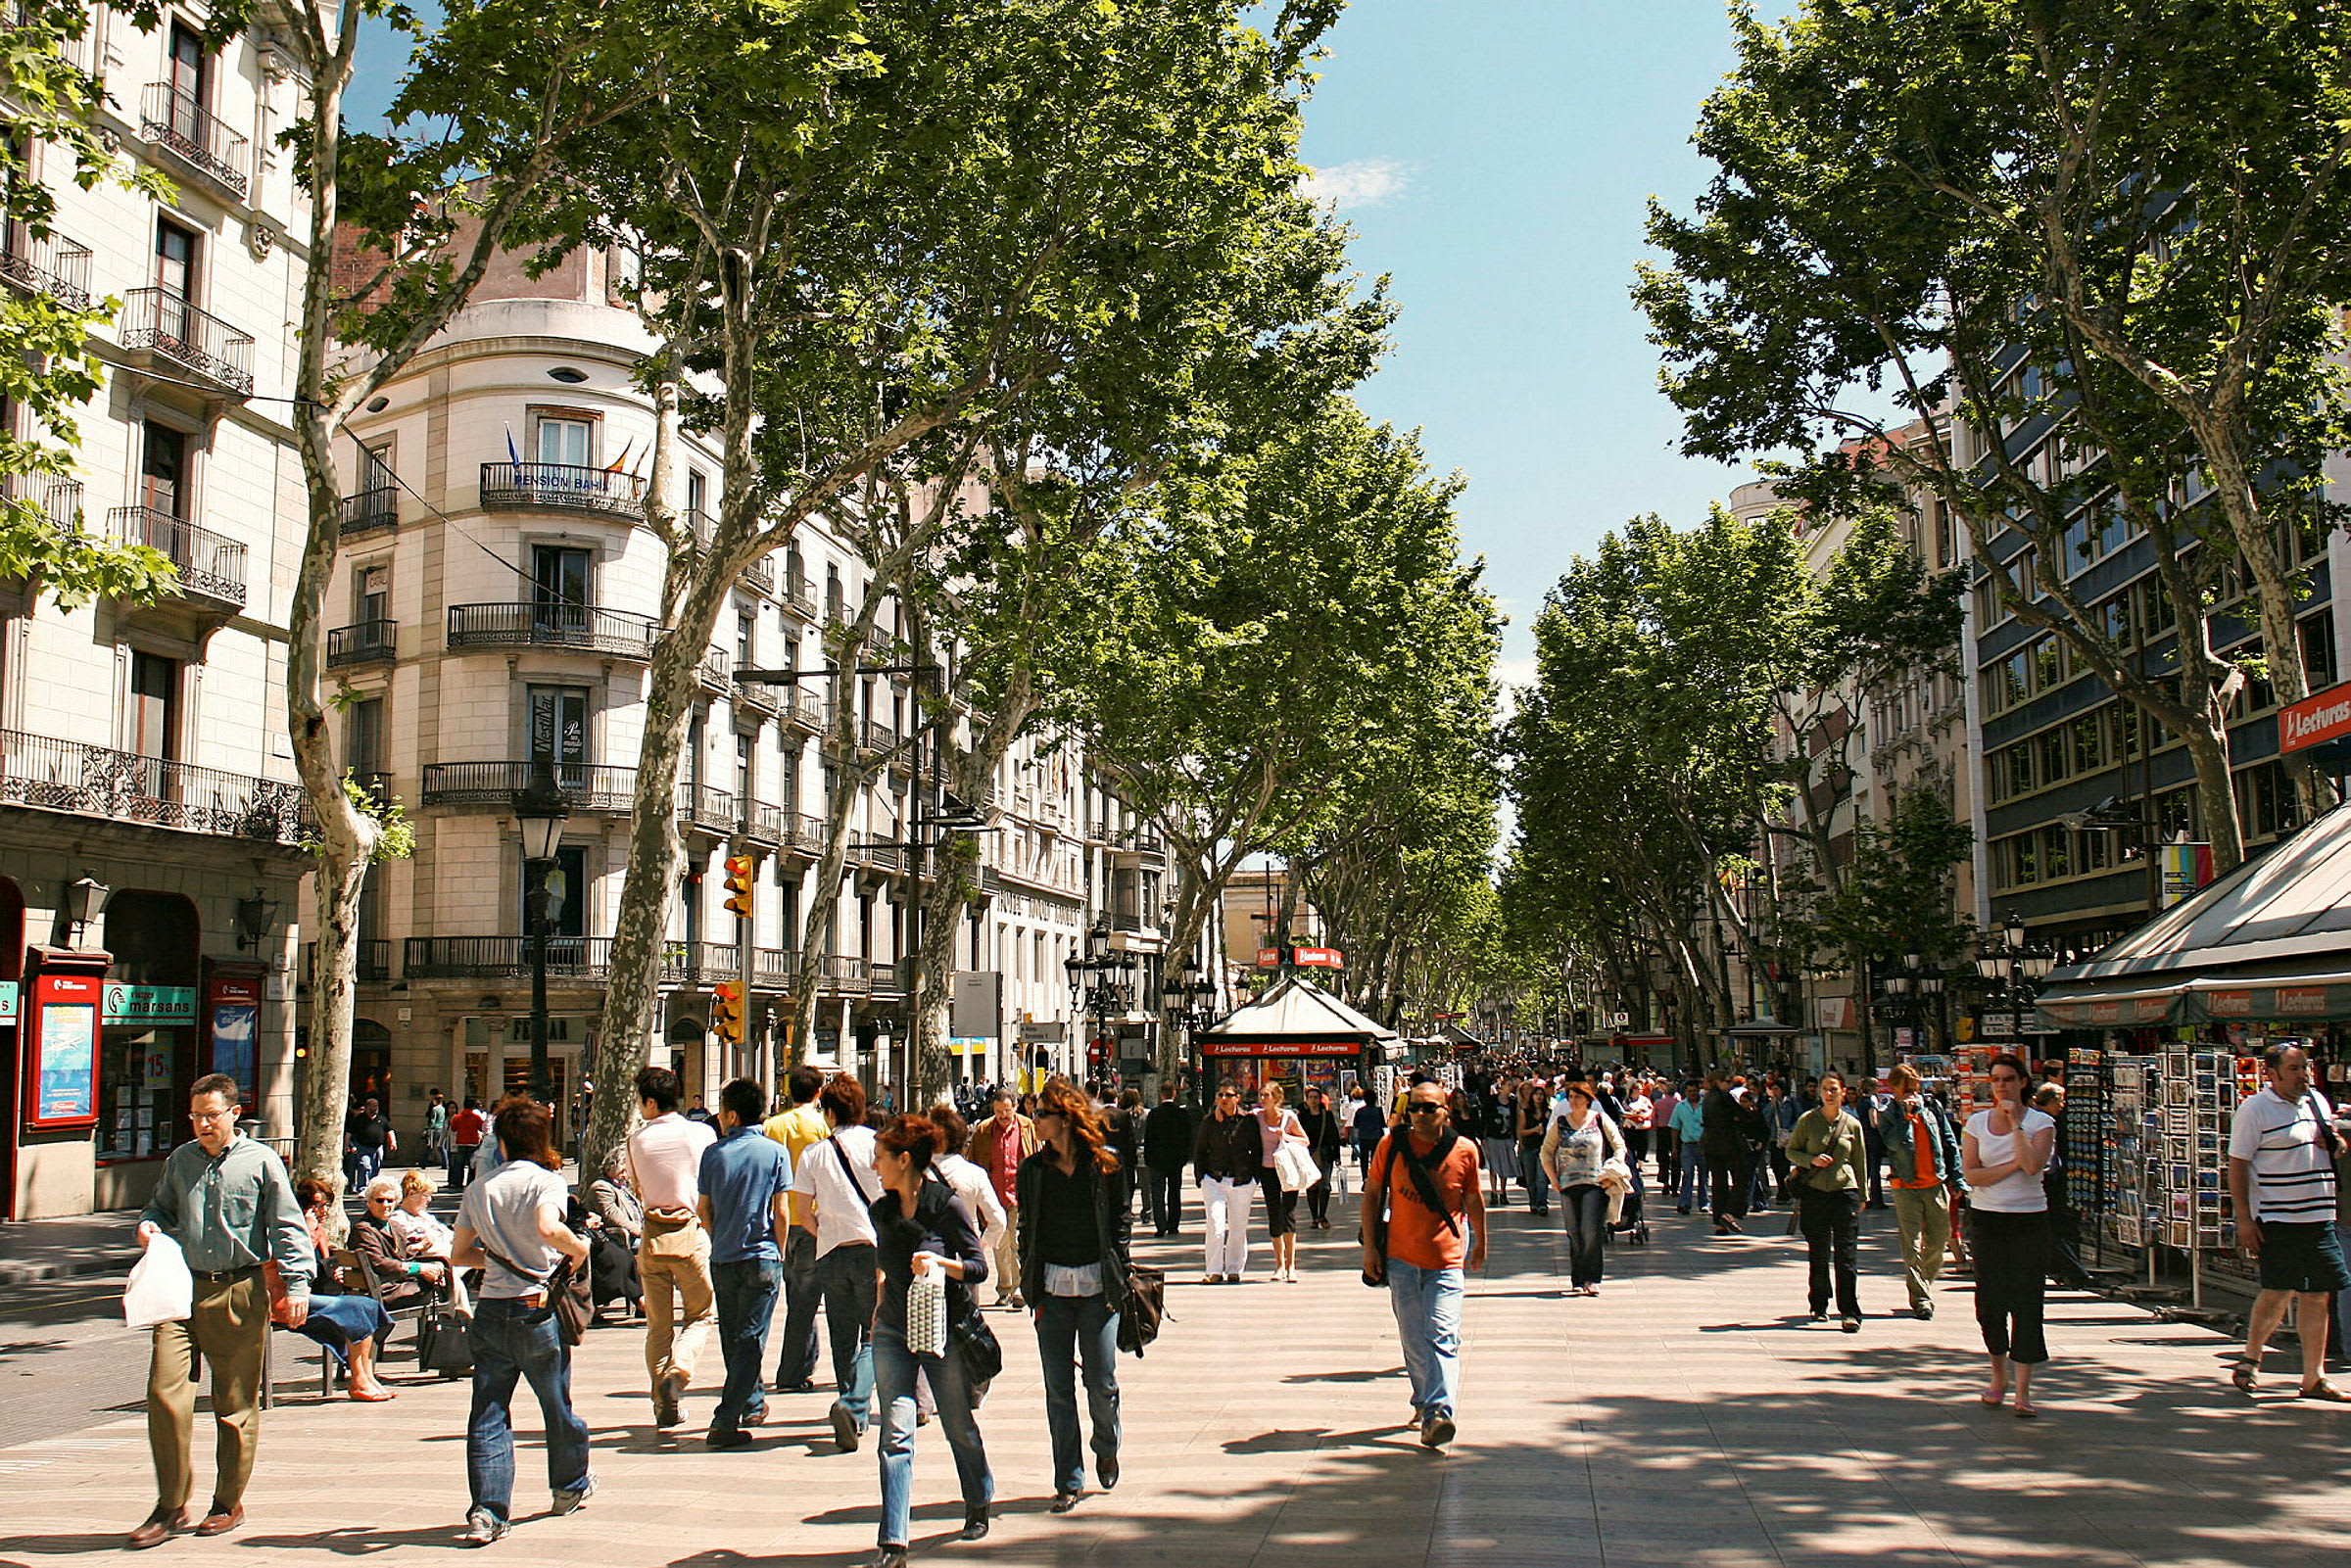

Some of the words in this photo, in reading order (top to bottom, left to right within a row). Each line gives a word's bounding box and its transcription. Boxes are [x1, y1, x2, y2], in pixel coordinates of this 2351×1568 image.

[2296, 700, 2350, 737] Lecturas
[129, 1002, 190, 1013] marsans
[2281, 990, 2327, 1012] Lecturas
